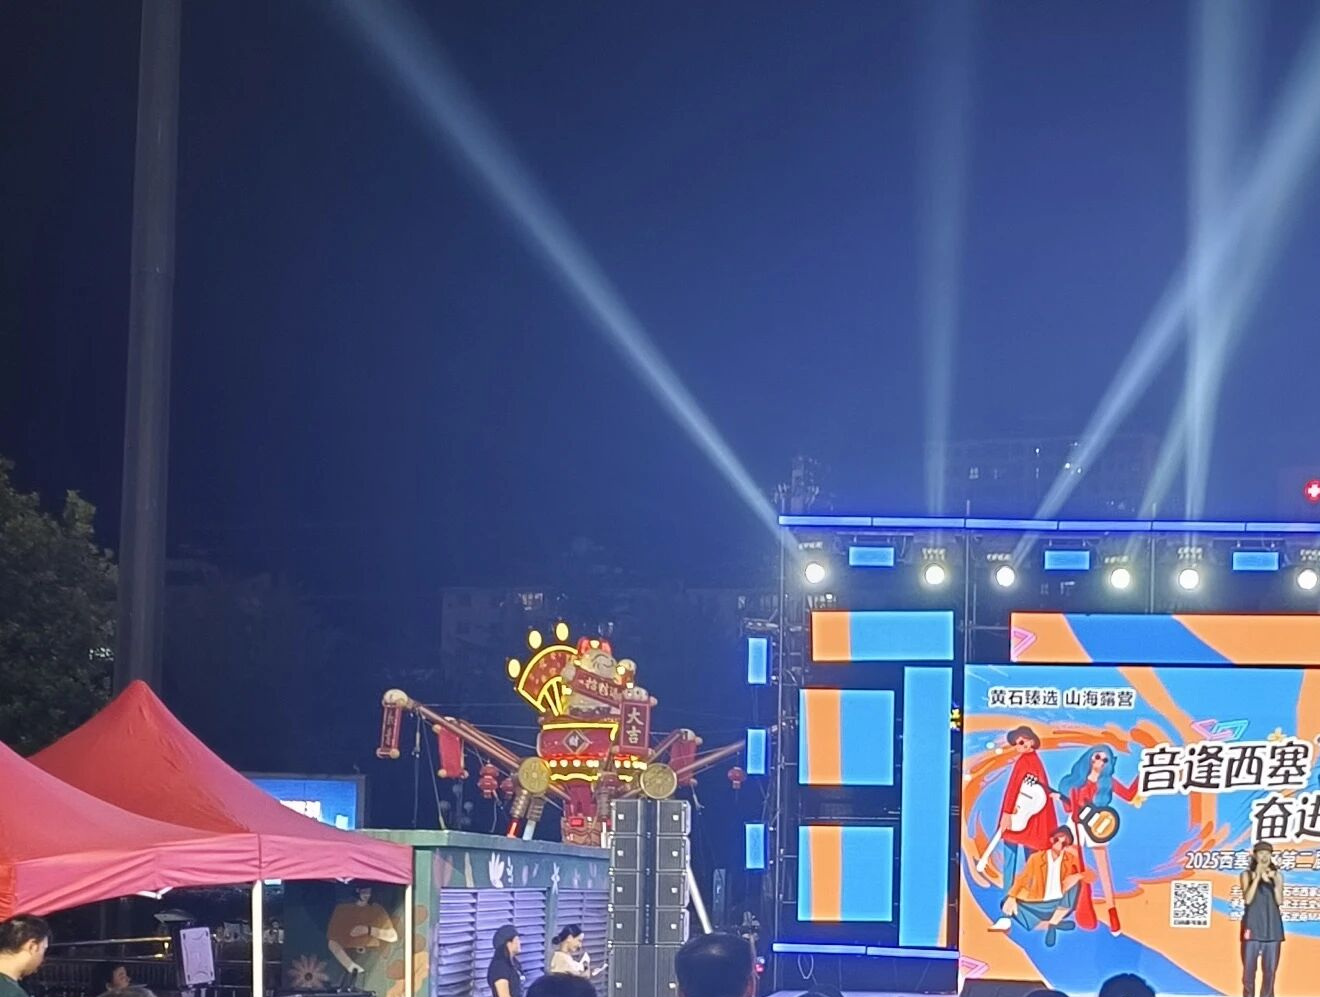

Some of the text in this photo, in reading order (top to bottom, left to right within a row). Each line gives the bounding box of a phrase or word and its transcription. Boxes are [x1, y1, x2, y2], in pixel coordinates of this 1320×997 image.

[991, 689, 1133, 707] 黄石臻选 山海露营
[626, 707, 644, 744] 大吉
[1141, 741, 1311, 793] 音逢西塞
